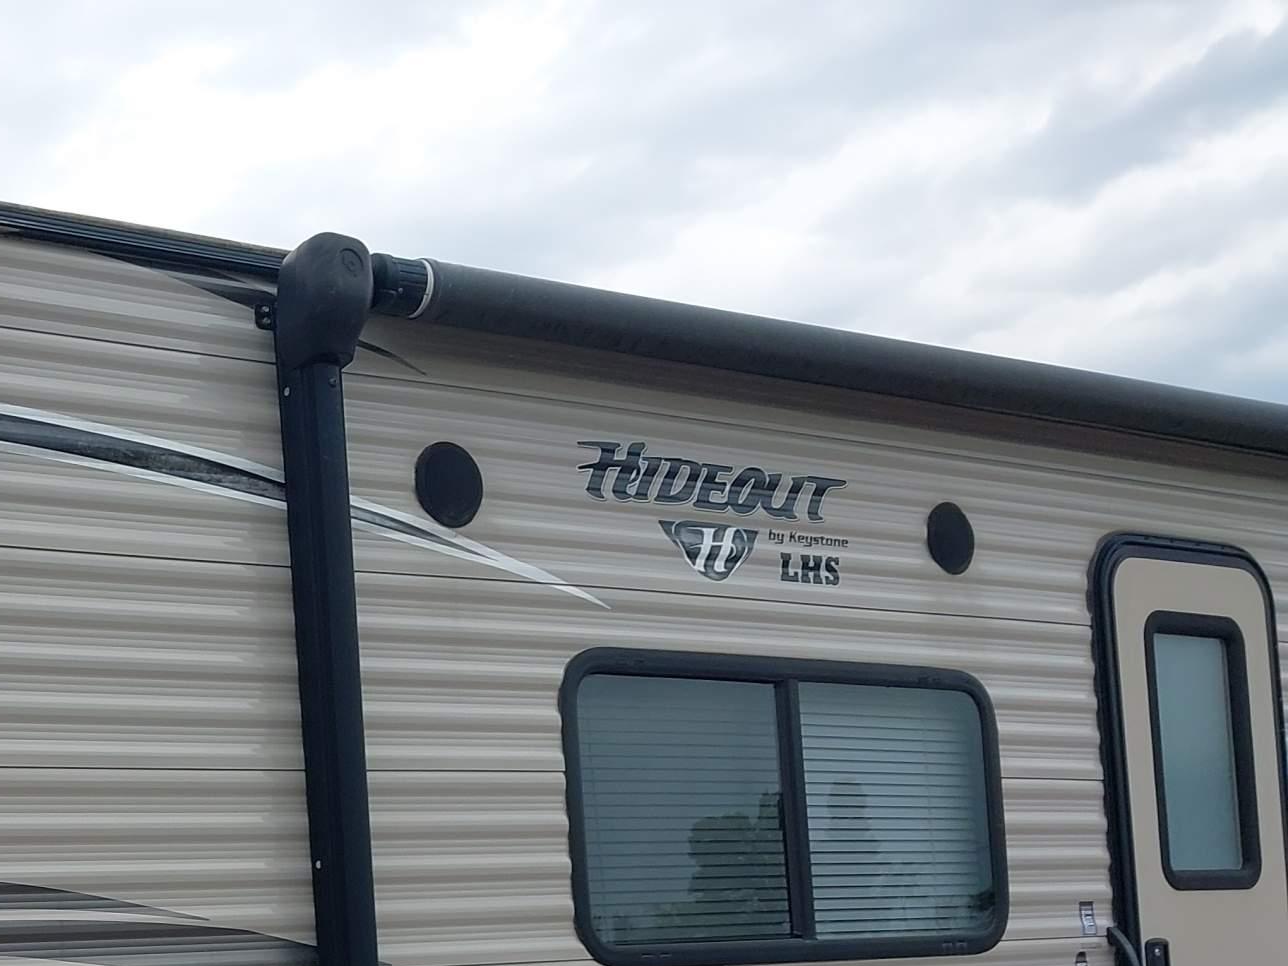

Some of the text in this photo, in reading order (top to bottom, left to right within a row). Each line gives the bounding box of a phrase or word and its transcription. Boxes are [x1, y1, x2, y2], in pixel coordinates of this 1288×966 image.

[576, 440, 848, 524] HIDEOUT
[768, 528, 850, 548] by Keystone
[779, 551, 841, 586] LHS
